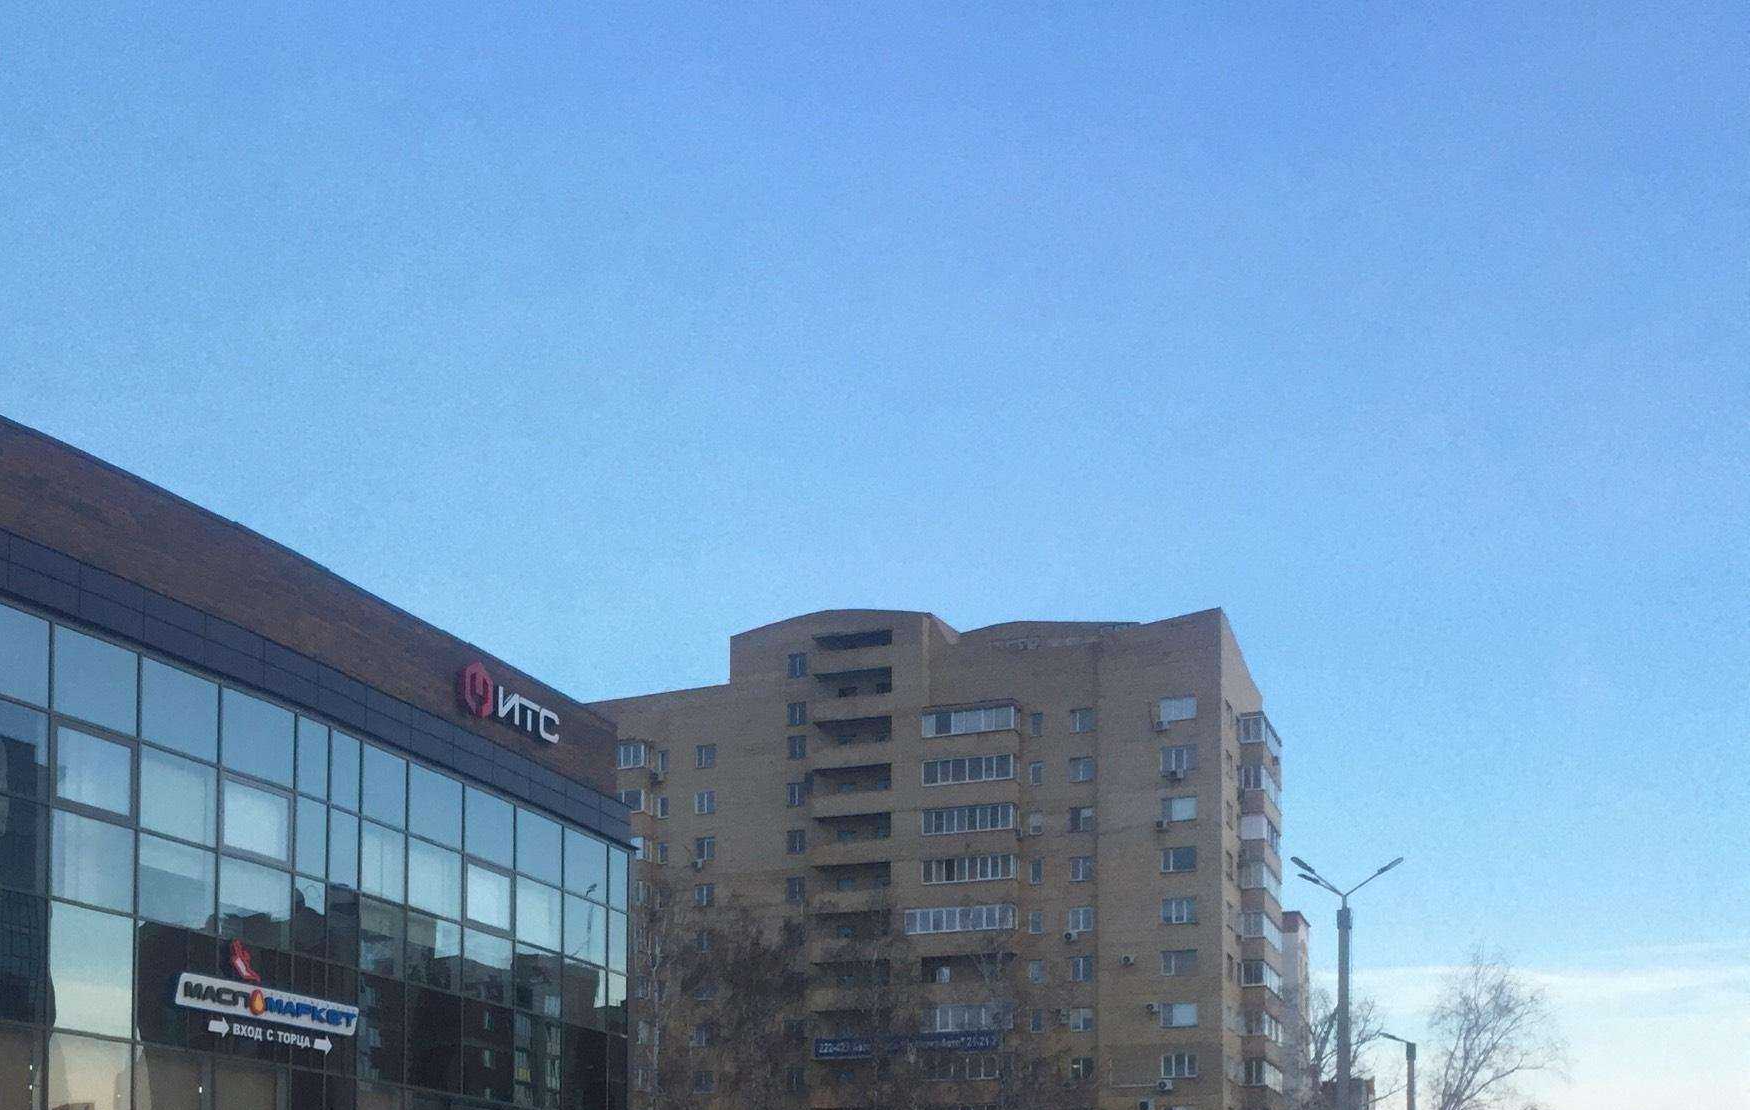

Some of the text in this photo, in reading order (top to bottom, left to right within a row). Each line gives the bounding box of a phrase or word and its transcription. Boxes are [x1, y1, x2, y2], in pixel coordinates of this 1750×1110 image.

[497, 685, 561, 745] ИТС
[232, 1022, 312, 1049] ВХОД С ТОРЦА
